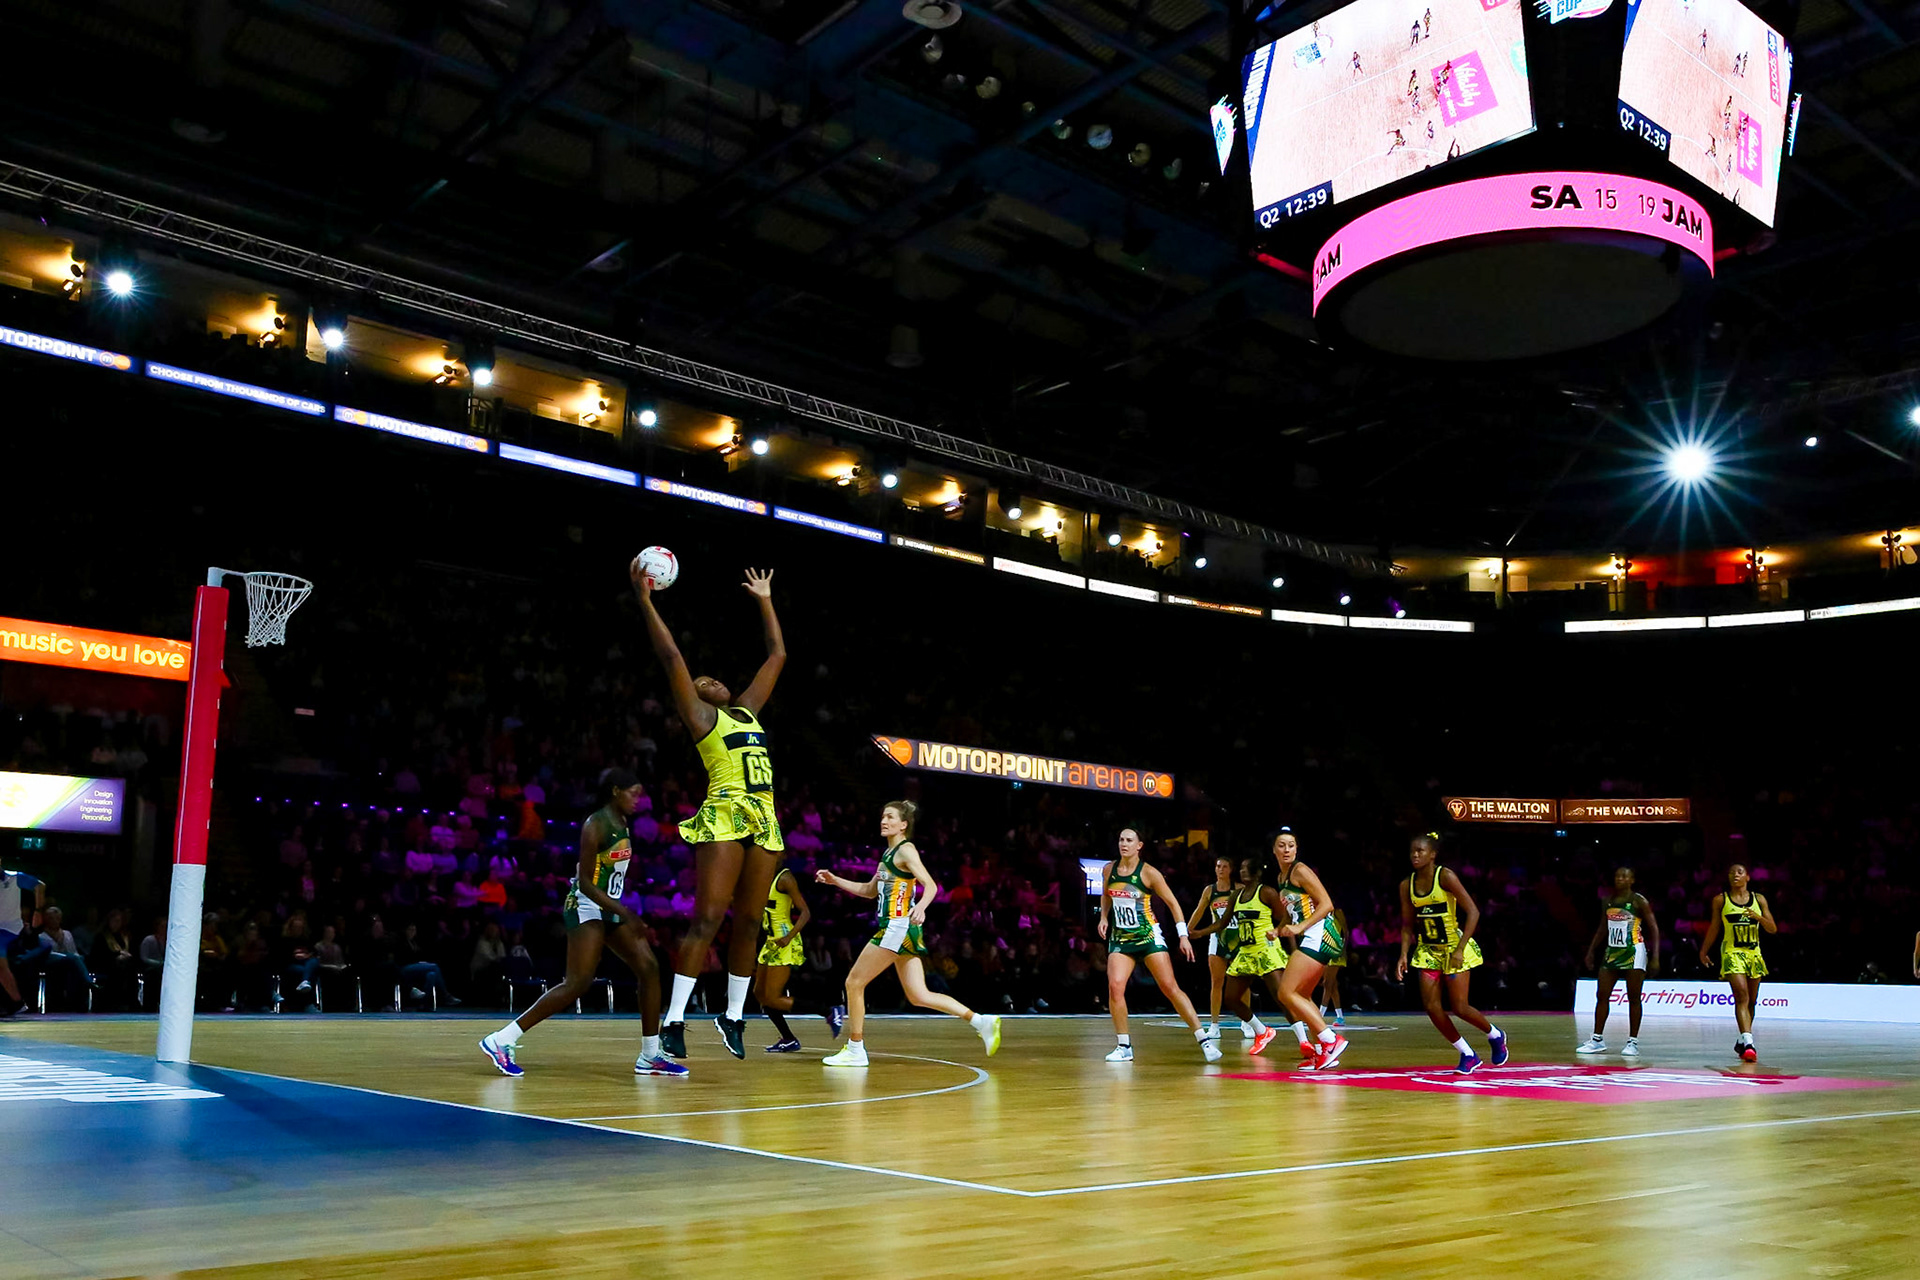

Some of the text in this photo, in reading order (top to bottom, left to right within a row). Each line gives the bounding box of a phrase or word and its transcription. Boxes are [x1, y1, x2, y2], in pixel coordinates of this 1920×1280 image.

[1769, 57, 1780, 104] sports
[1619, 107, 1667, 150] Q2 12:39
[1260, 189, 1327, 229] Q2 12:39
[1530, 184, 1704, 241] SA 15 19 JAM
[0, 327, 97, 362] TORPOINT
[150, 365, 326, 414] CHOOSE FROM THOUSANDS OF CARS
[369, 414, 463, 446] MOTORPOINT
[672, 483, 745, 509] MOTORPOINT
[0, 630, 186, 669] music you love
[746, 755, 773, 785] GS
[917, 742, 1067, 783] MOTORPOINT
[1067, 762, 1138, 792] arena
[84, 798, 113, 806] Innovation
[94, 790, 114, 799] Design
[1469, 801, 1550, 813] THE WALTON
[80, 805, 112, 815] Engineering
[81, 813, 112, 822] Personified
[1586, 806, 1664, 816] THE WALTON
[1424, 918, 1438, 939] C
[1610, 927, 1625, 945] WA
